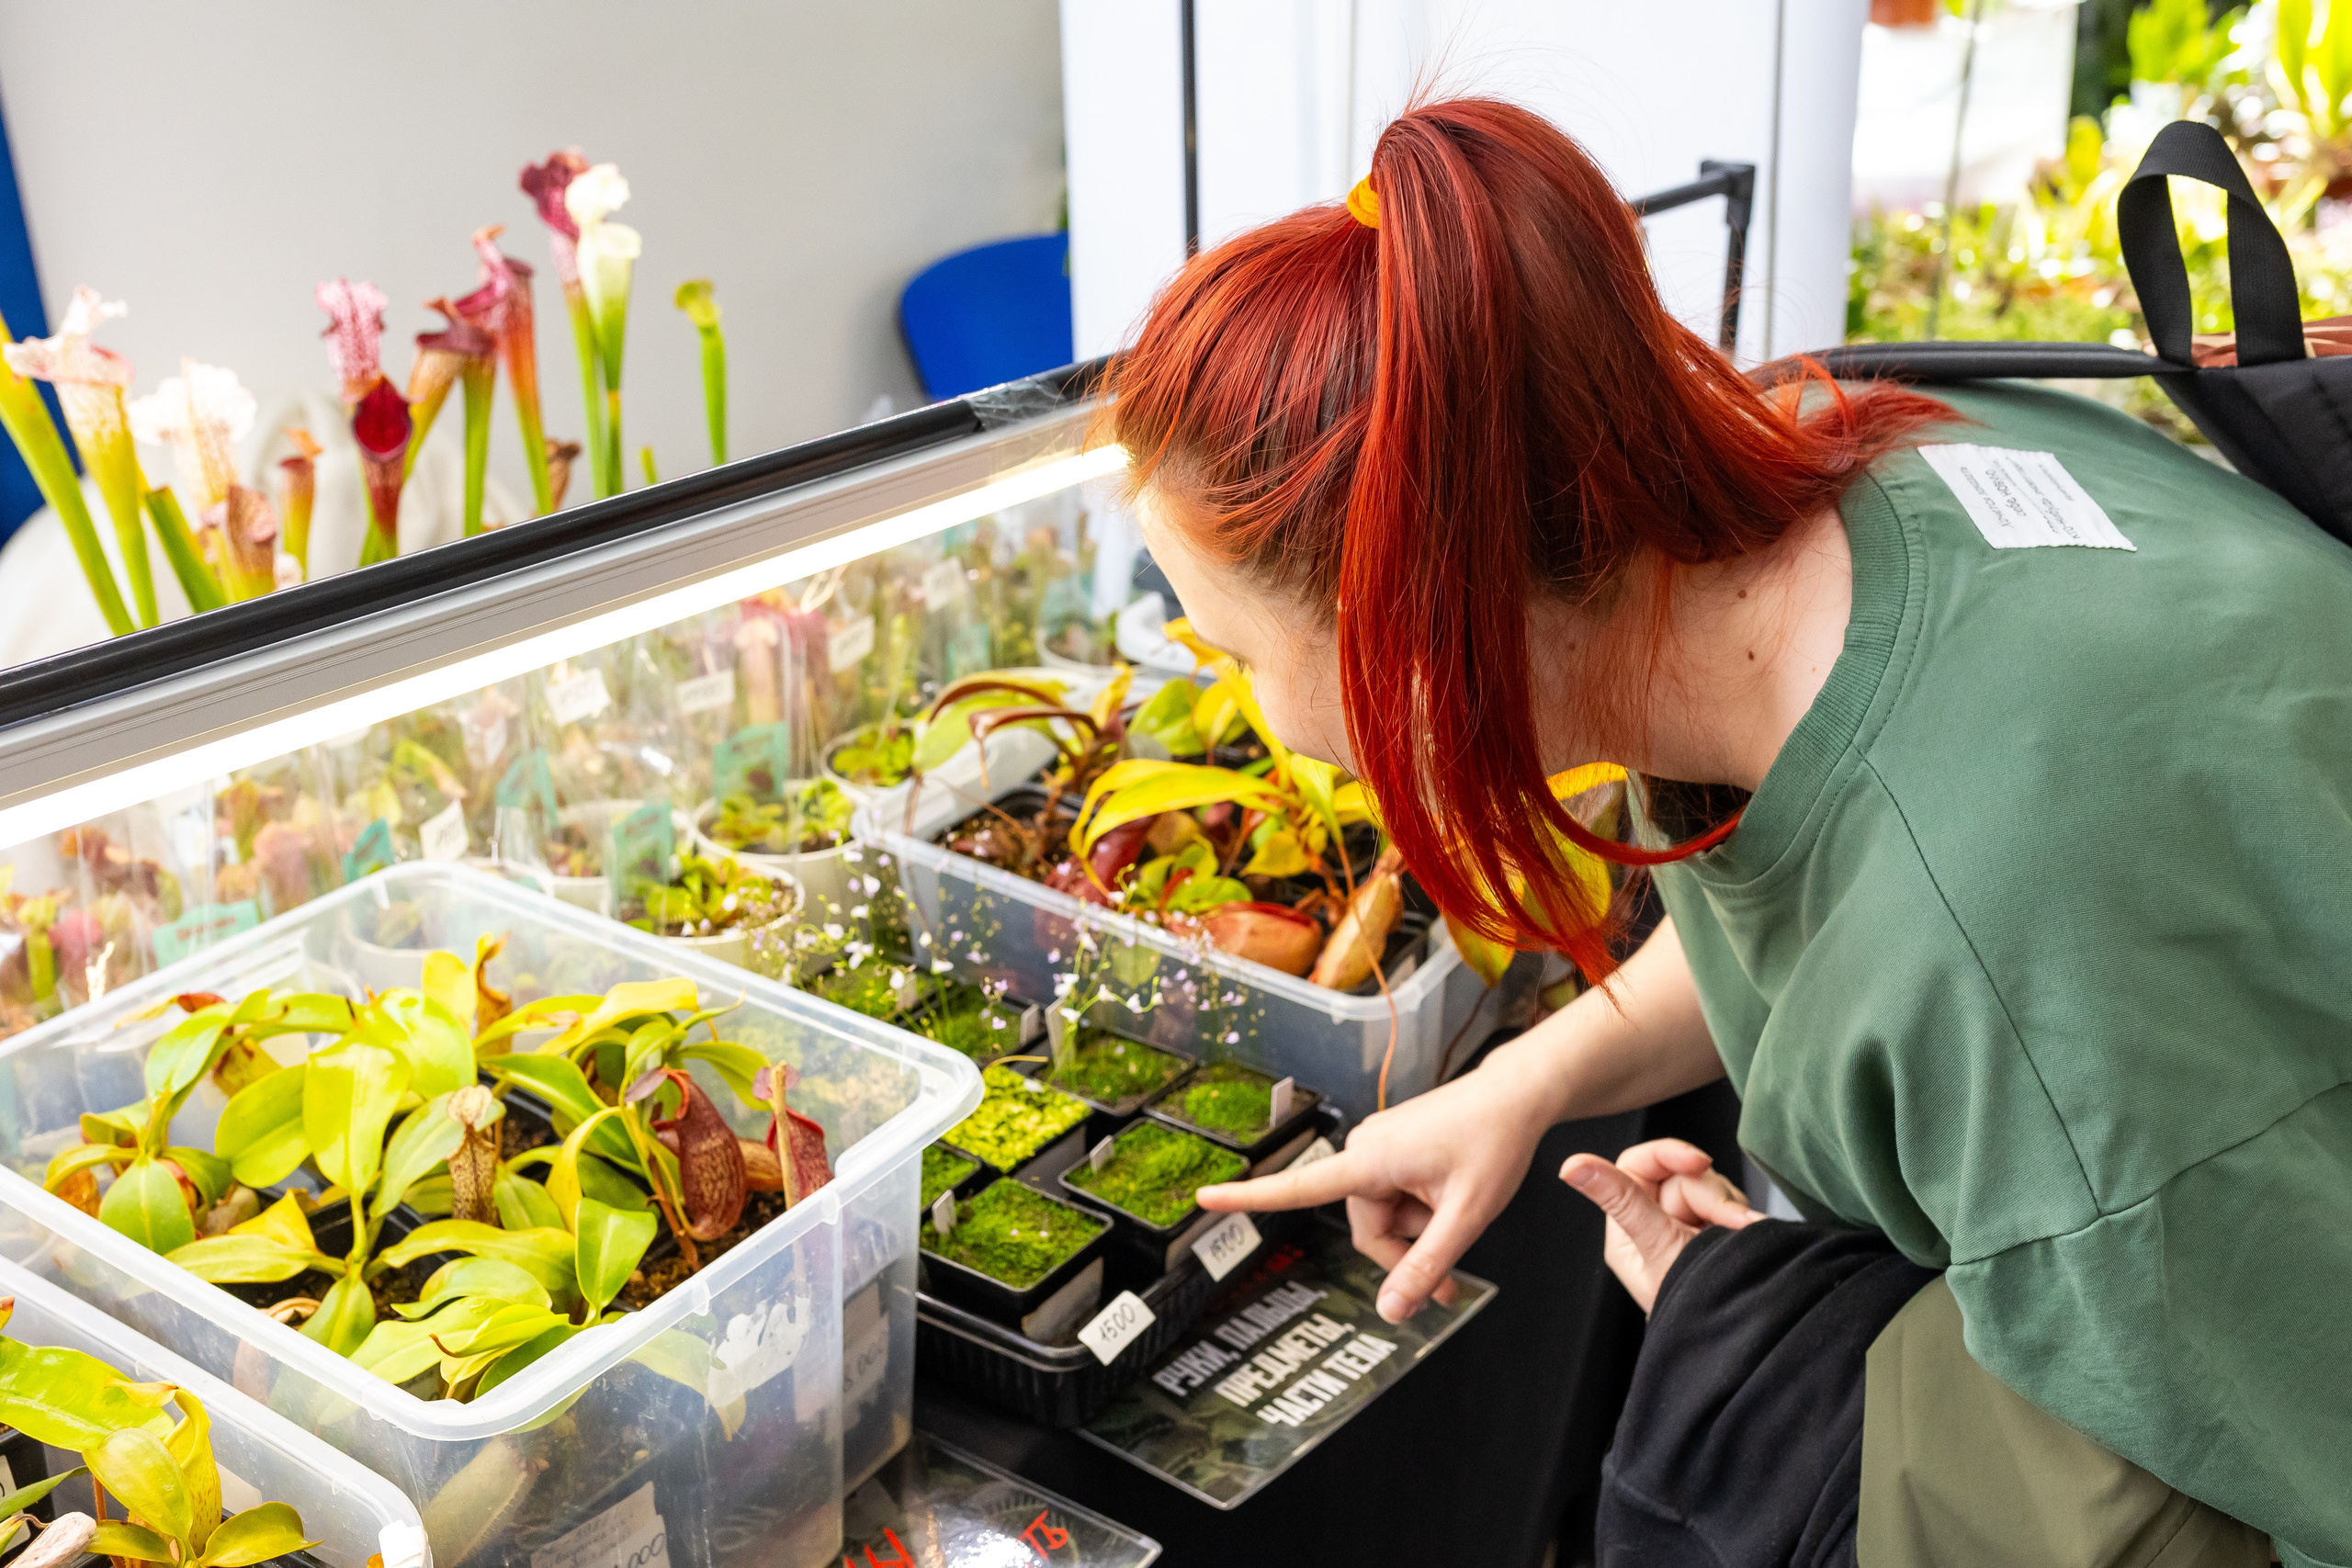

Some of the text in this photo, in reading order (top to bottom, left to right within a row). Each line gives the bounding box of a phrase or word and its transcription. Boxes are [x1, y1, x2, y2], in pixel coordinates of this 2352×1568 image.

[2006, 497, 2027, 517] себе
[1209, 1223, 1245, 1263] 1500
[1098, 1302, 1136, 1344] 1500
[1152, 1280, 1329, 1397] РУКИ, ПАЛЬЦЫ,
[1213, 1312, 1356, 1408] ПРЕДМЕТЫ,
[1255, 1332, 1398, 1427] ЧАСТИ ТЕЛА
